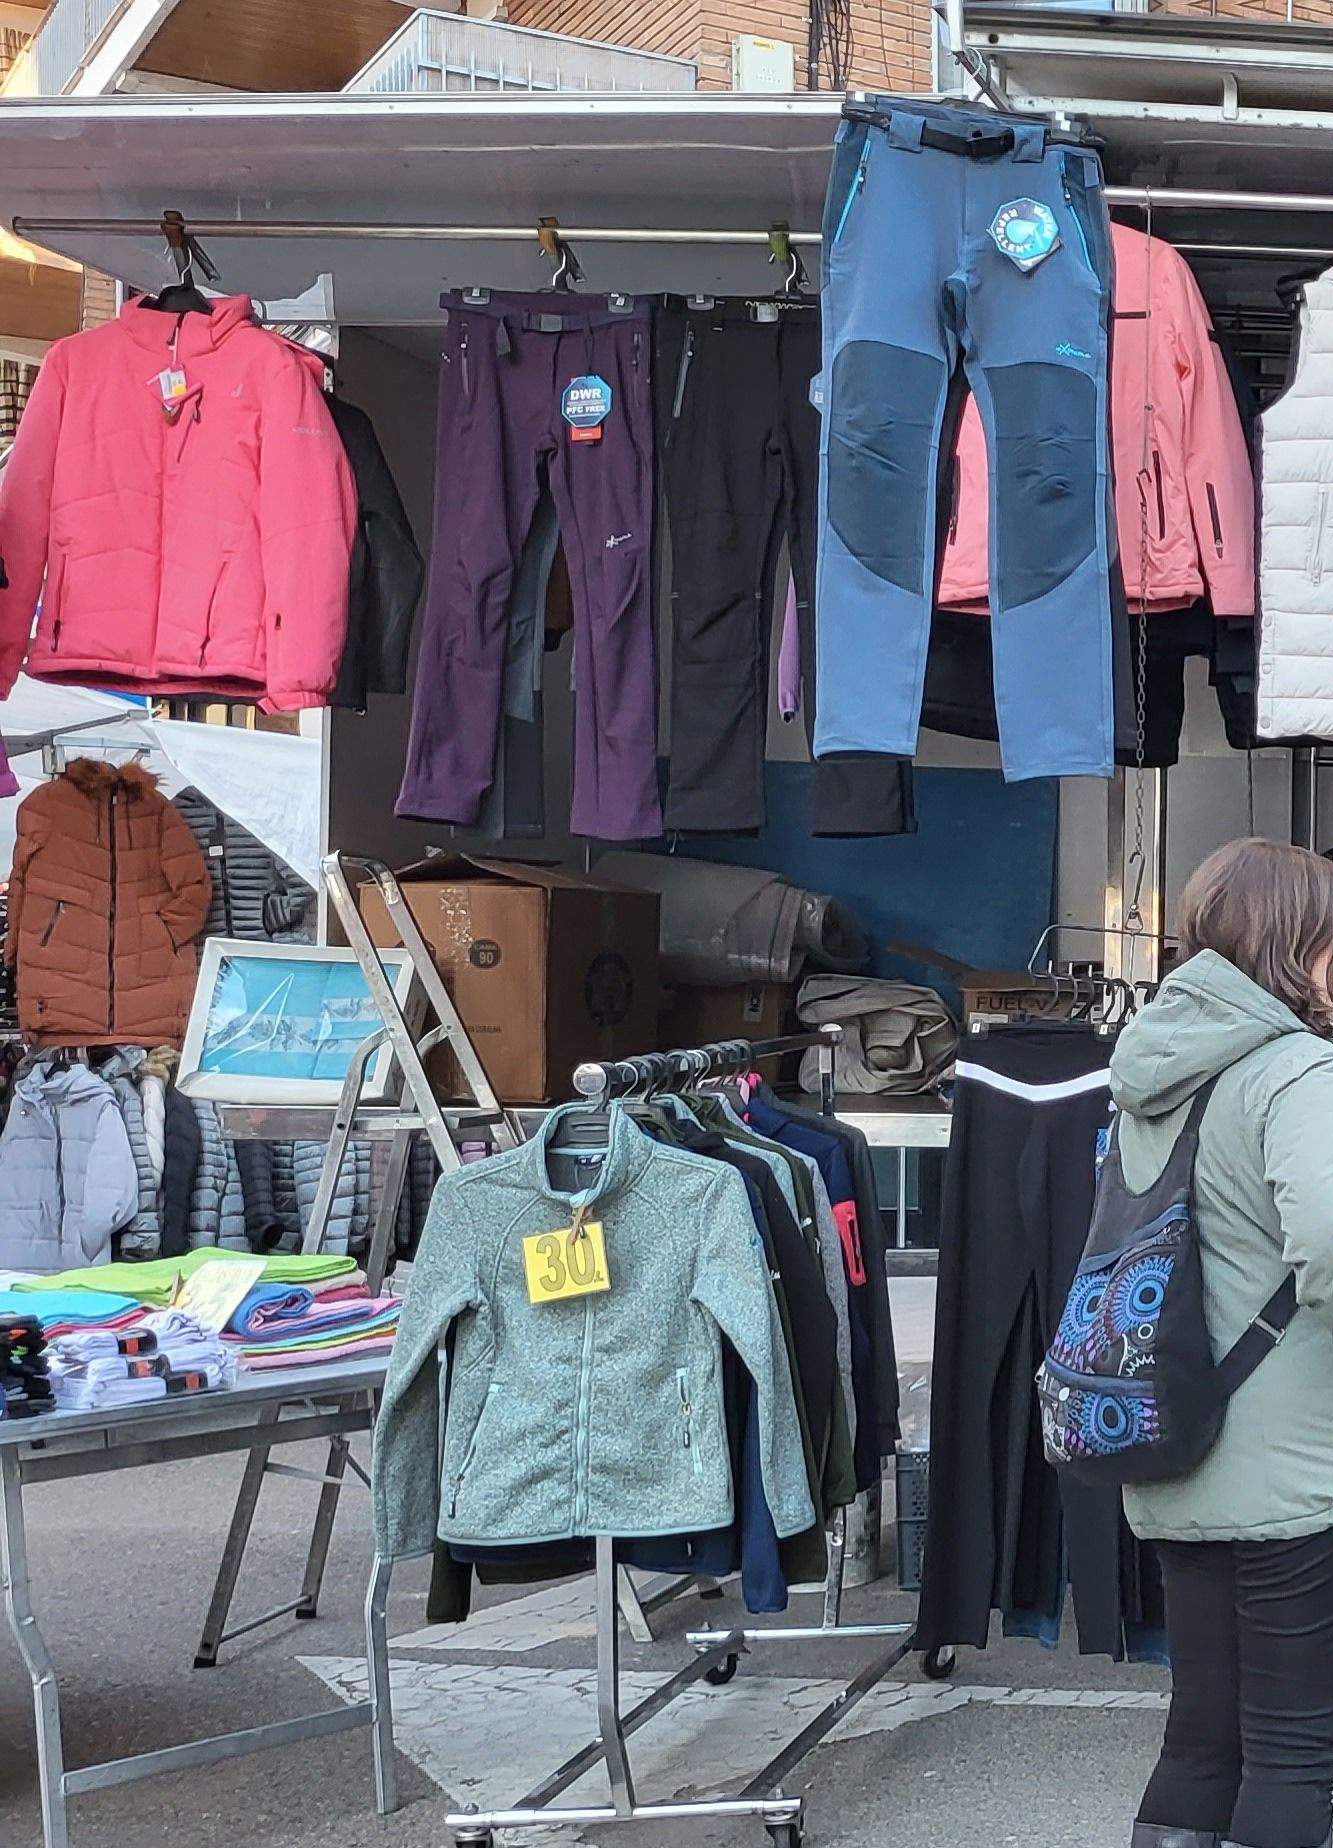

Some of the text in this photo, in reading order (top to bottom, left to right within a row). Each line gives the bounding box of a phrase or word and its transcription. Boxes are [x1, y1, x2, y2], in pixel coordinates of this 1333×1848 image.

[995, 208, 1033, 254] REPELLENT
[570, 388, 602, 400] DWR
[566, 404, 606, 415] PFC FREE
[479, 951, 494, 964] 90
[536, 1234, 596, 1292] 30
